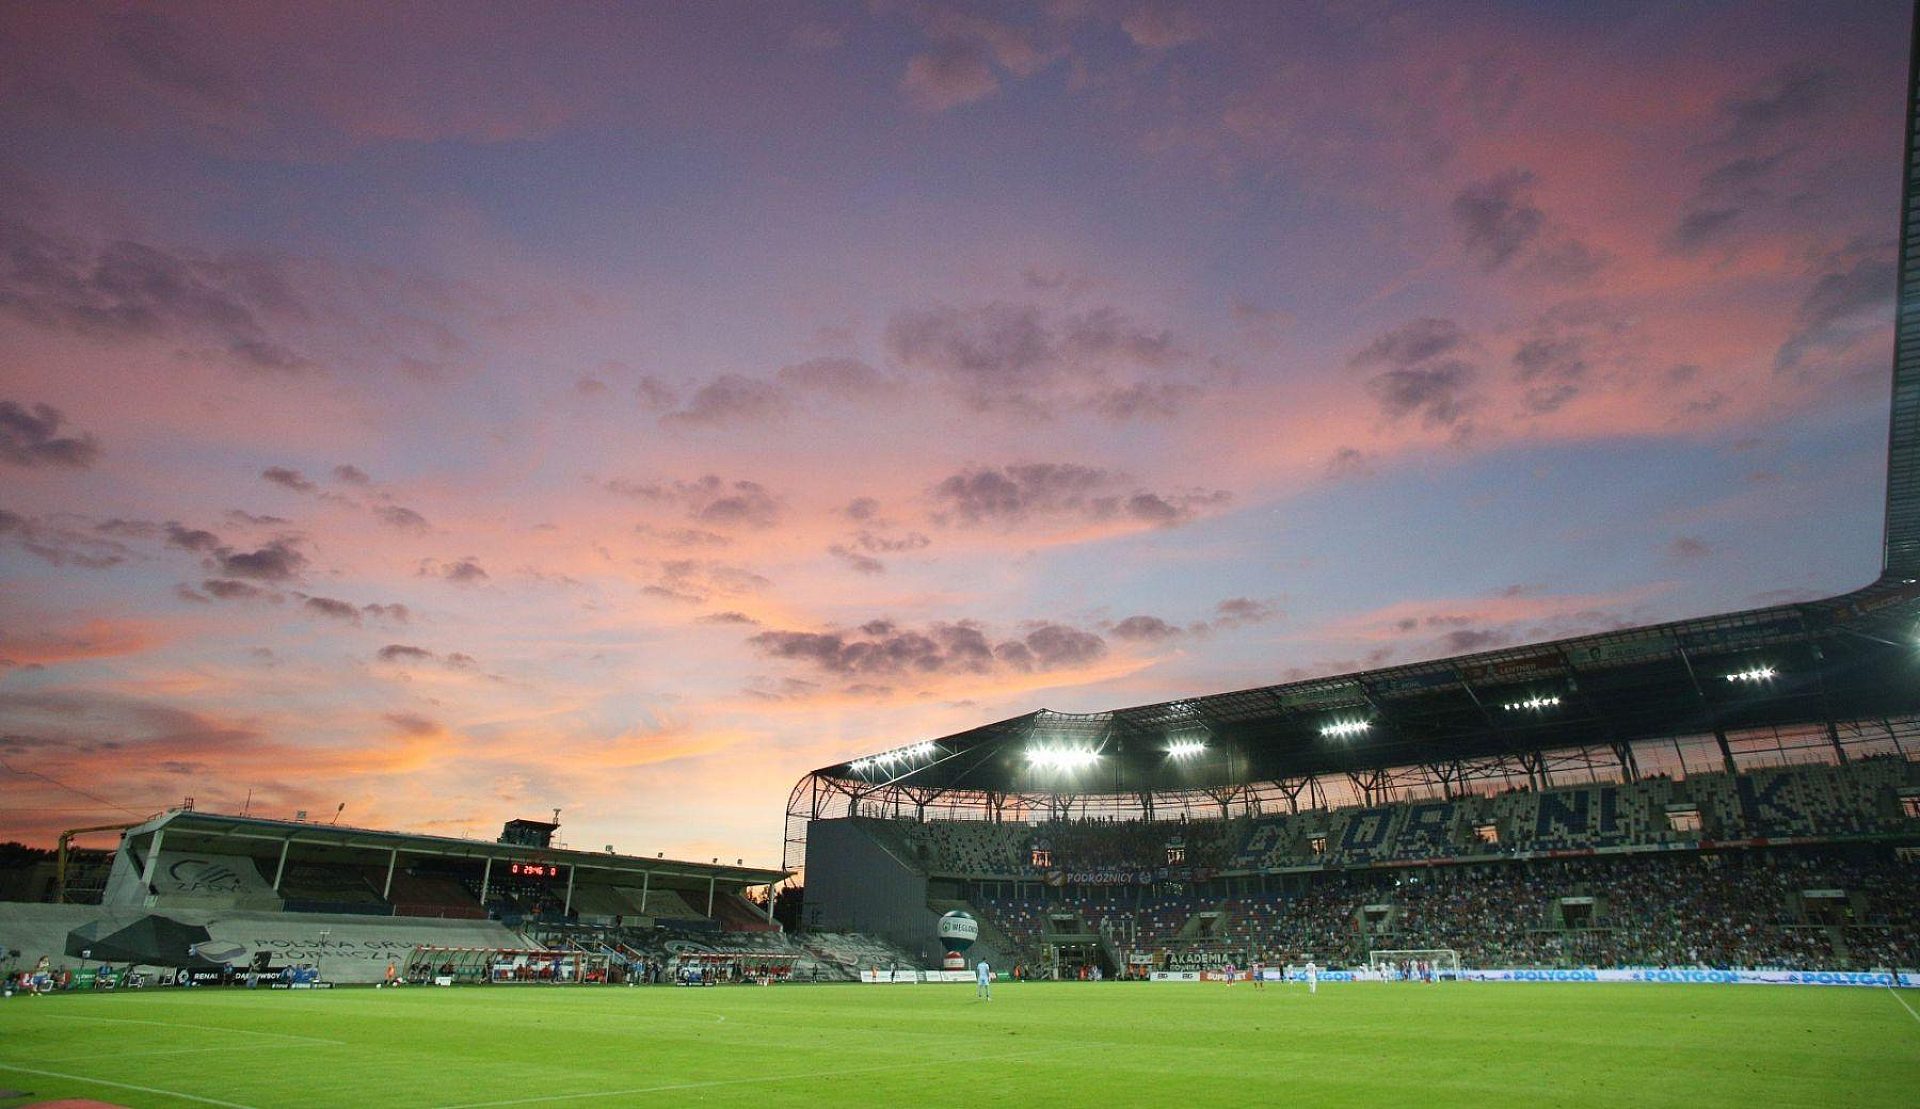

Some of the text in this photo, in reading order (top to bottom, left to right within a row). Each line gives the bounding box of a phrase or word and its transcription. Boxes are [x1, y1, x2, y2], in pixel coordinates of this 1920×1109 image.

[512, 864, 518, 874] 0
[550, 867, 556, 876] 0
[1170, 953, 1229, 964] AKADEMIA
[1513, 970, 1598, 981] POLYGON
[1644, 970, 1739, 982] POLYGON
